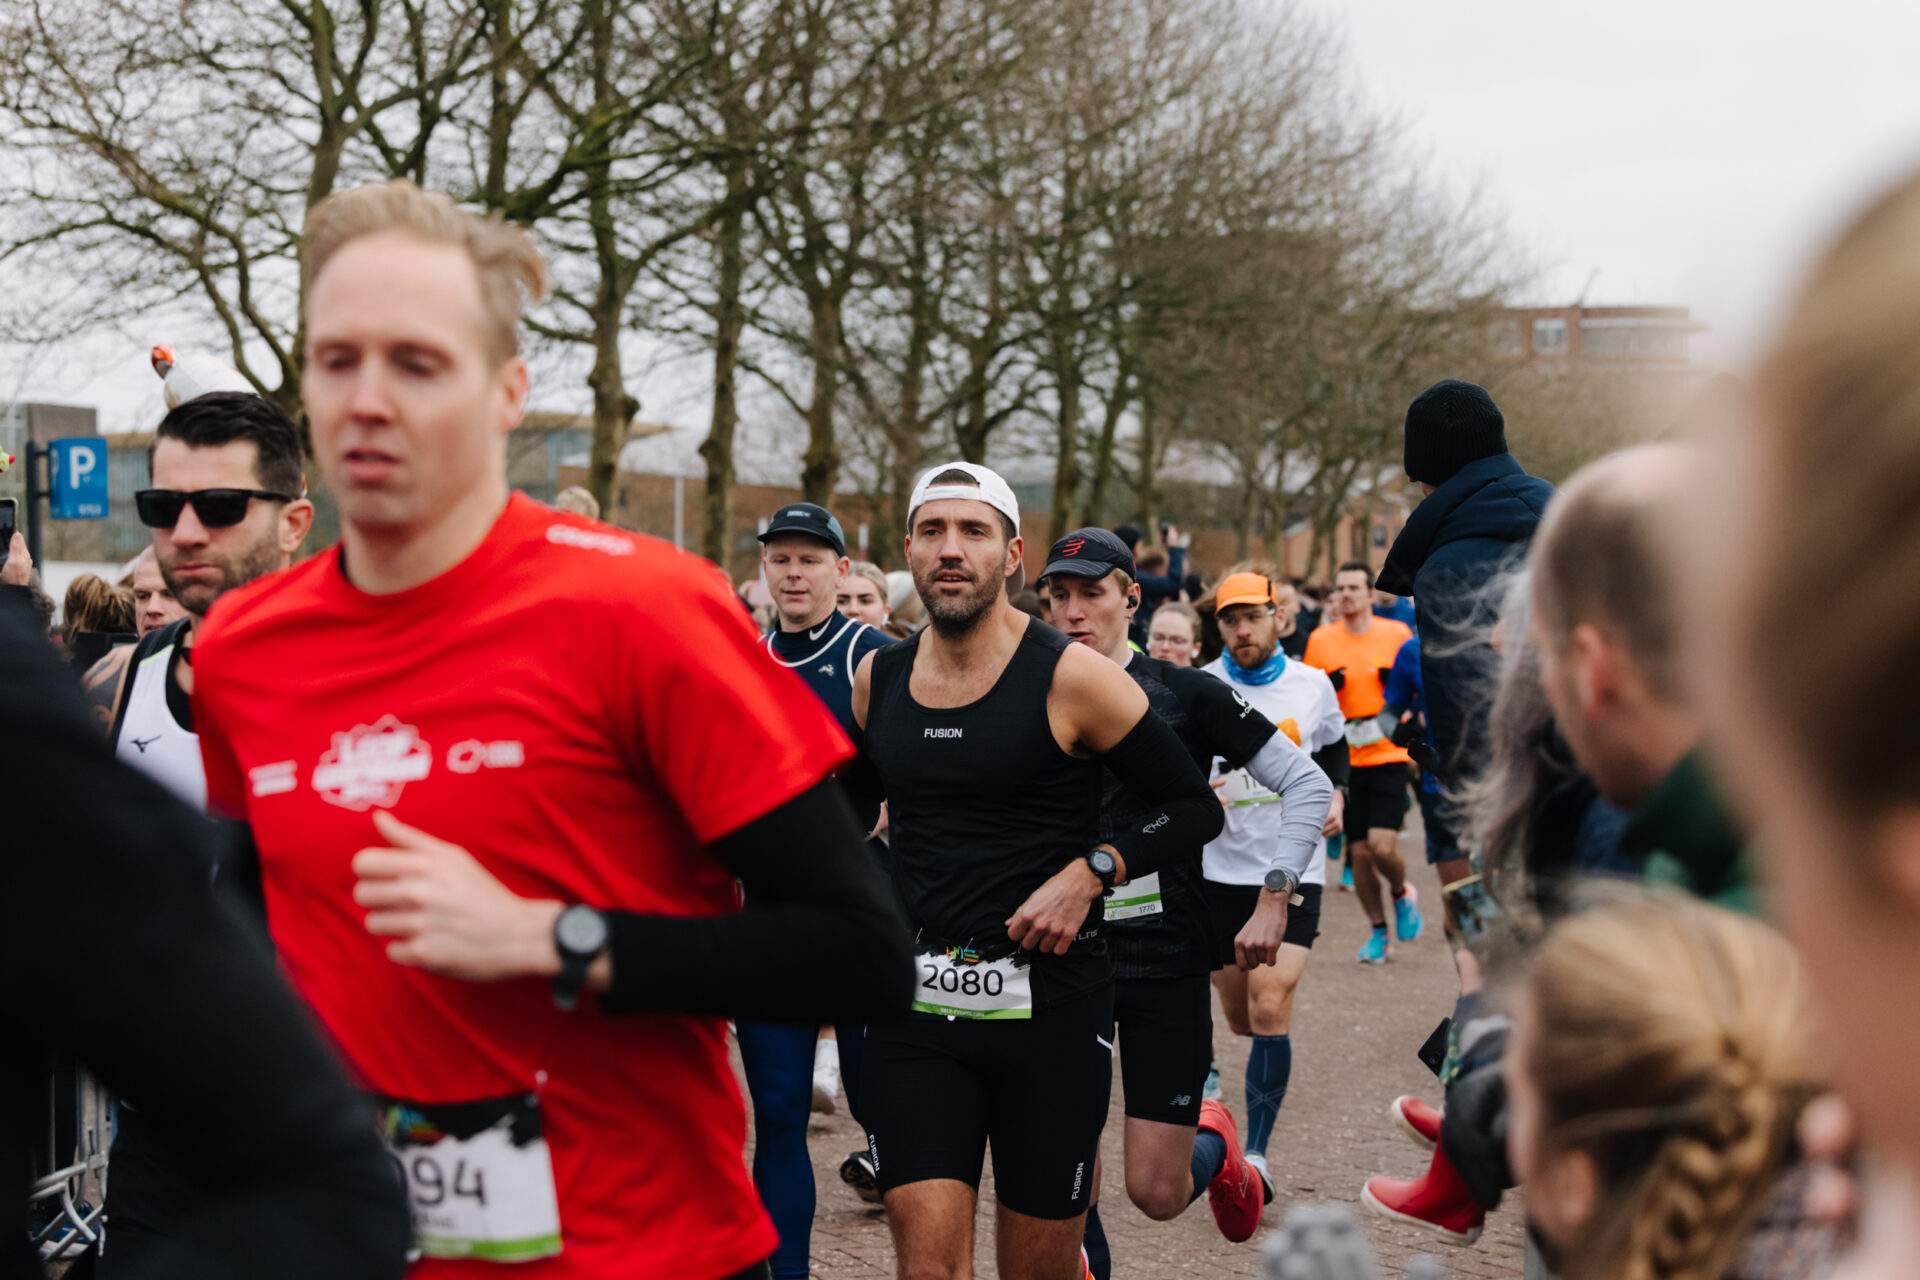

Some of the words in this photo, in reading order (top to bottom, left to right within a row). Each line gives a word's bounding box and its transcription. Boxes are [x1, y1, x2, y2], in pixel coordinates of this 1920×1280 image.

[69, 446, 96, 490] P
[924, 727, 963, 738] FUSION
[1139, 903, 1156, 913] 1770
[922, 963, 1003, 996] 2080
[868, 1134, 881, 1172] FUSION
[396, 1155, 488, 1207] 94
[1071, 1161, 1085, 1200] FUSION
